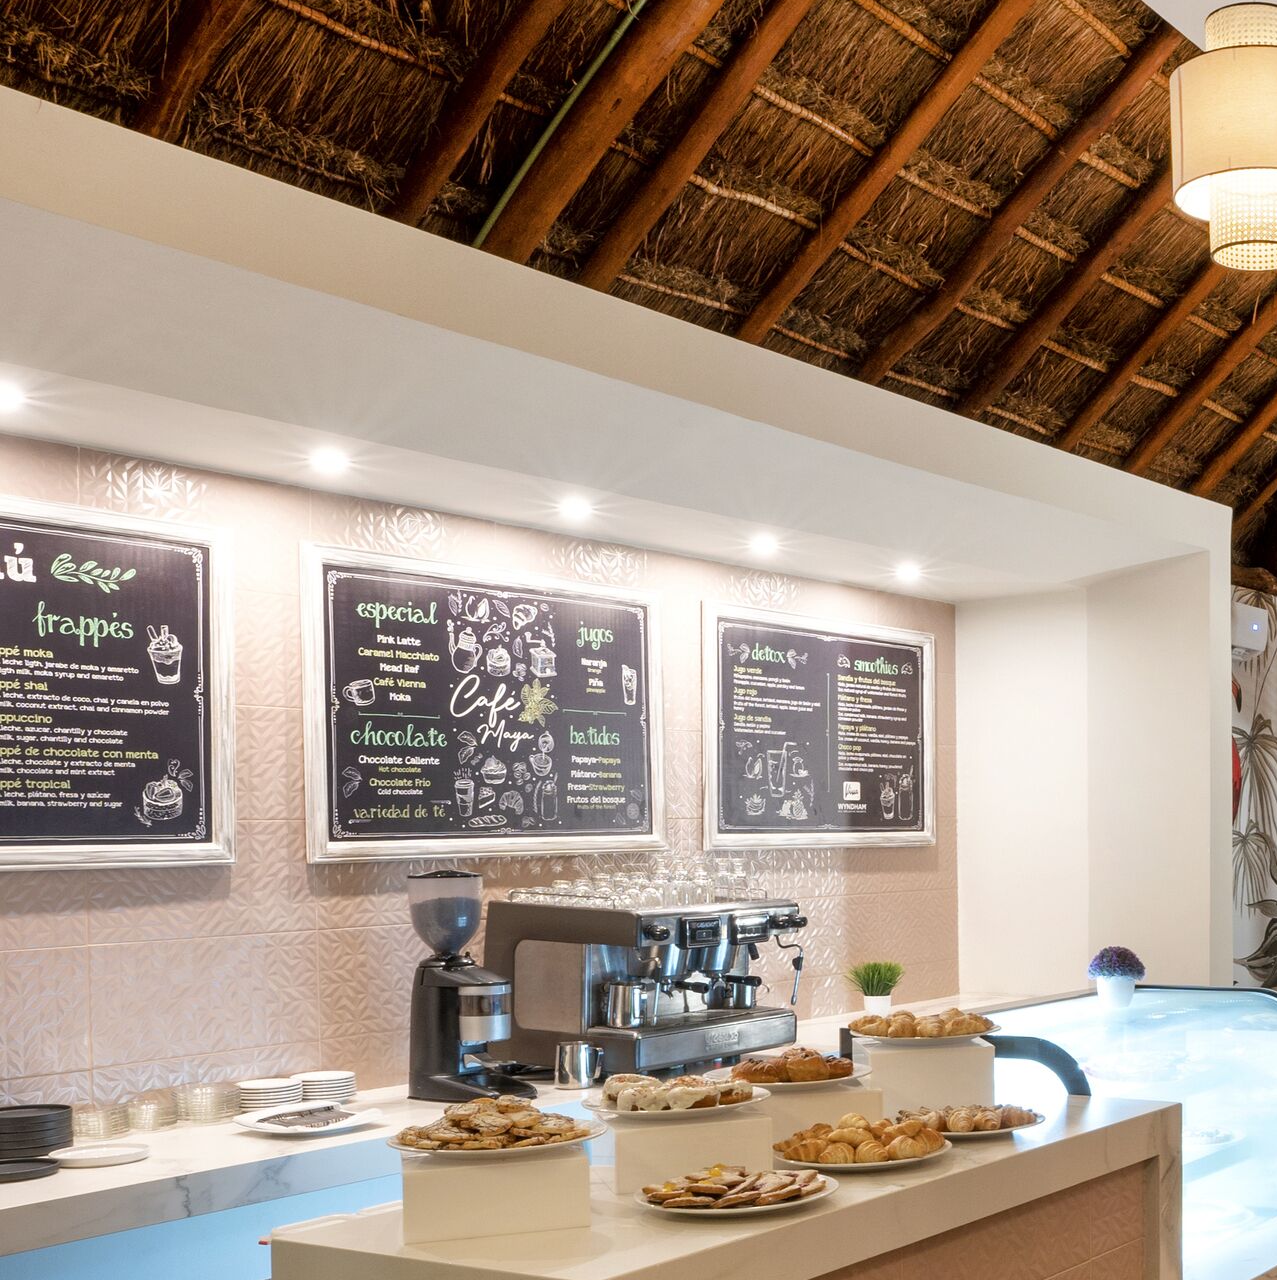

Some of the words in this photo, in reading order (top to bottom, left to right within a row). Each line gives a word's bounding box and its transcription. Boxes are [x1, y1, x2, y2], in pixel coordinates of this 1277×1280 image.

[355, 601, 438, 628] especial
[32, 600, 135, 648] frappés
[377, 634, 396, 645] Pink
[396, 636, 422, 646] Latte
[576, 620, 614, 651] jugos
[23, 648, 54, 658] moka
[358, 647, 394, 659] Caramel
[395, 650, 440, 662] Macchiato
[751, 642, 787, 664] detox
[853, 656, 899, 676] smoothies
[373, 677, 395, 687] Café
[396, 679, 427, 689] Vienna
[389, 692, 412, 702] Moka
[450, 674, 521, 729] Café
[350, 720, 448, 748] chocolate
[476, 719, 535, 752] Maya
[570, 724, 621, 746] batidos
[25, 746, 40, 756] de
[43, 747, 100, 758] chocolate
[102, 750, 123, 759] con
[125, 751, 159, 760] menta
[358, 755, 403, 765] Chocolate
[404, 756, 440, 766] Caliente
[25, 779, 71, 790] tropical
[369, 778, 414, 787] Chocolate
[566, 795, 589, 804] Frutos
[590, 796, 601, 804] del
[602, 796, 626, 806] bosque
[837, 803, 868, 811] WYNDHAM
[353, 804, 411, 819] variedad
[414, 804, 428, 818] de
[432, 804, 446, 818] té
